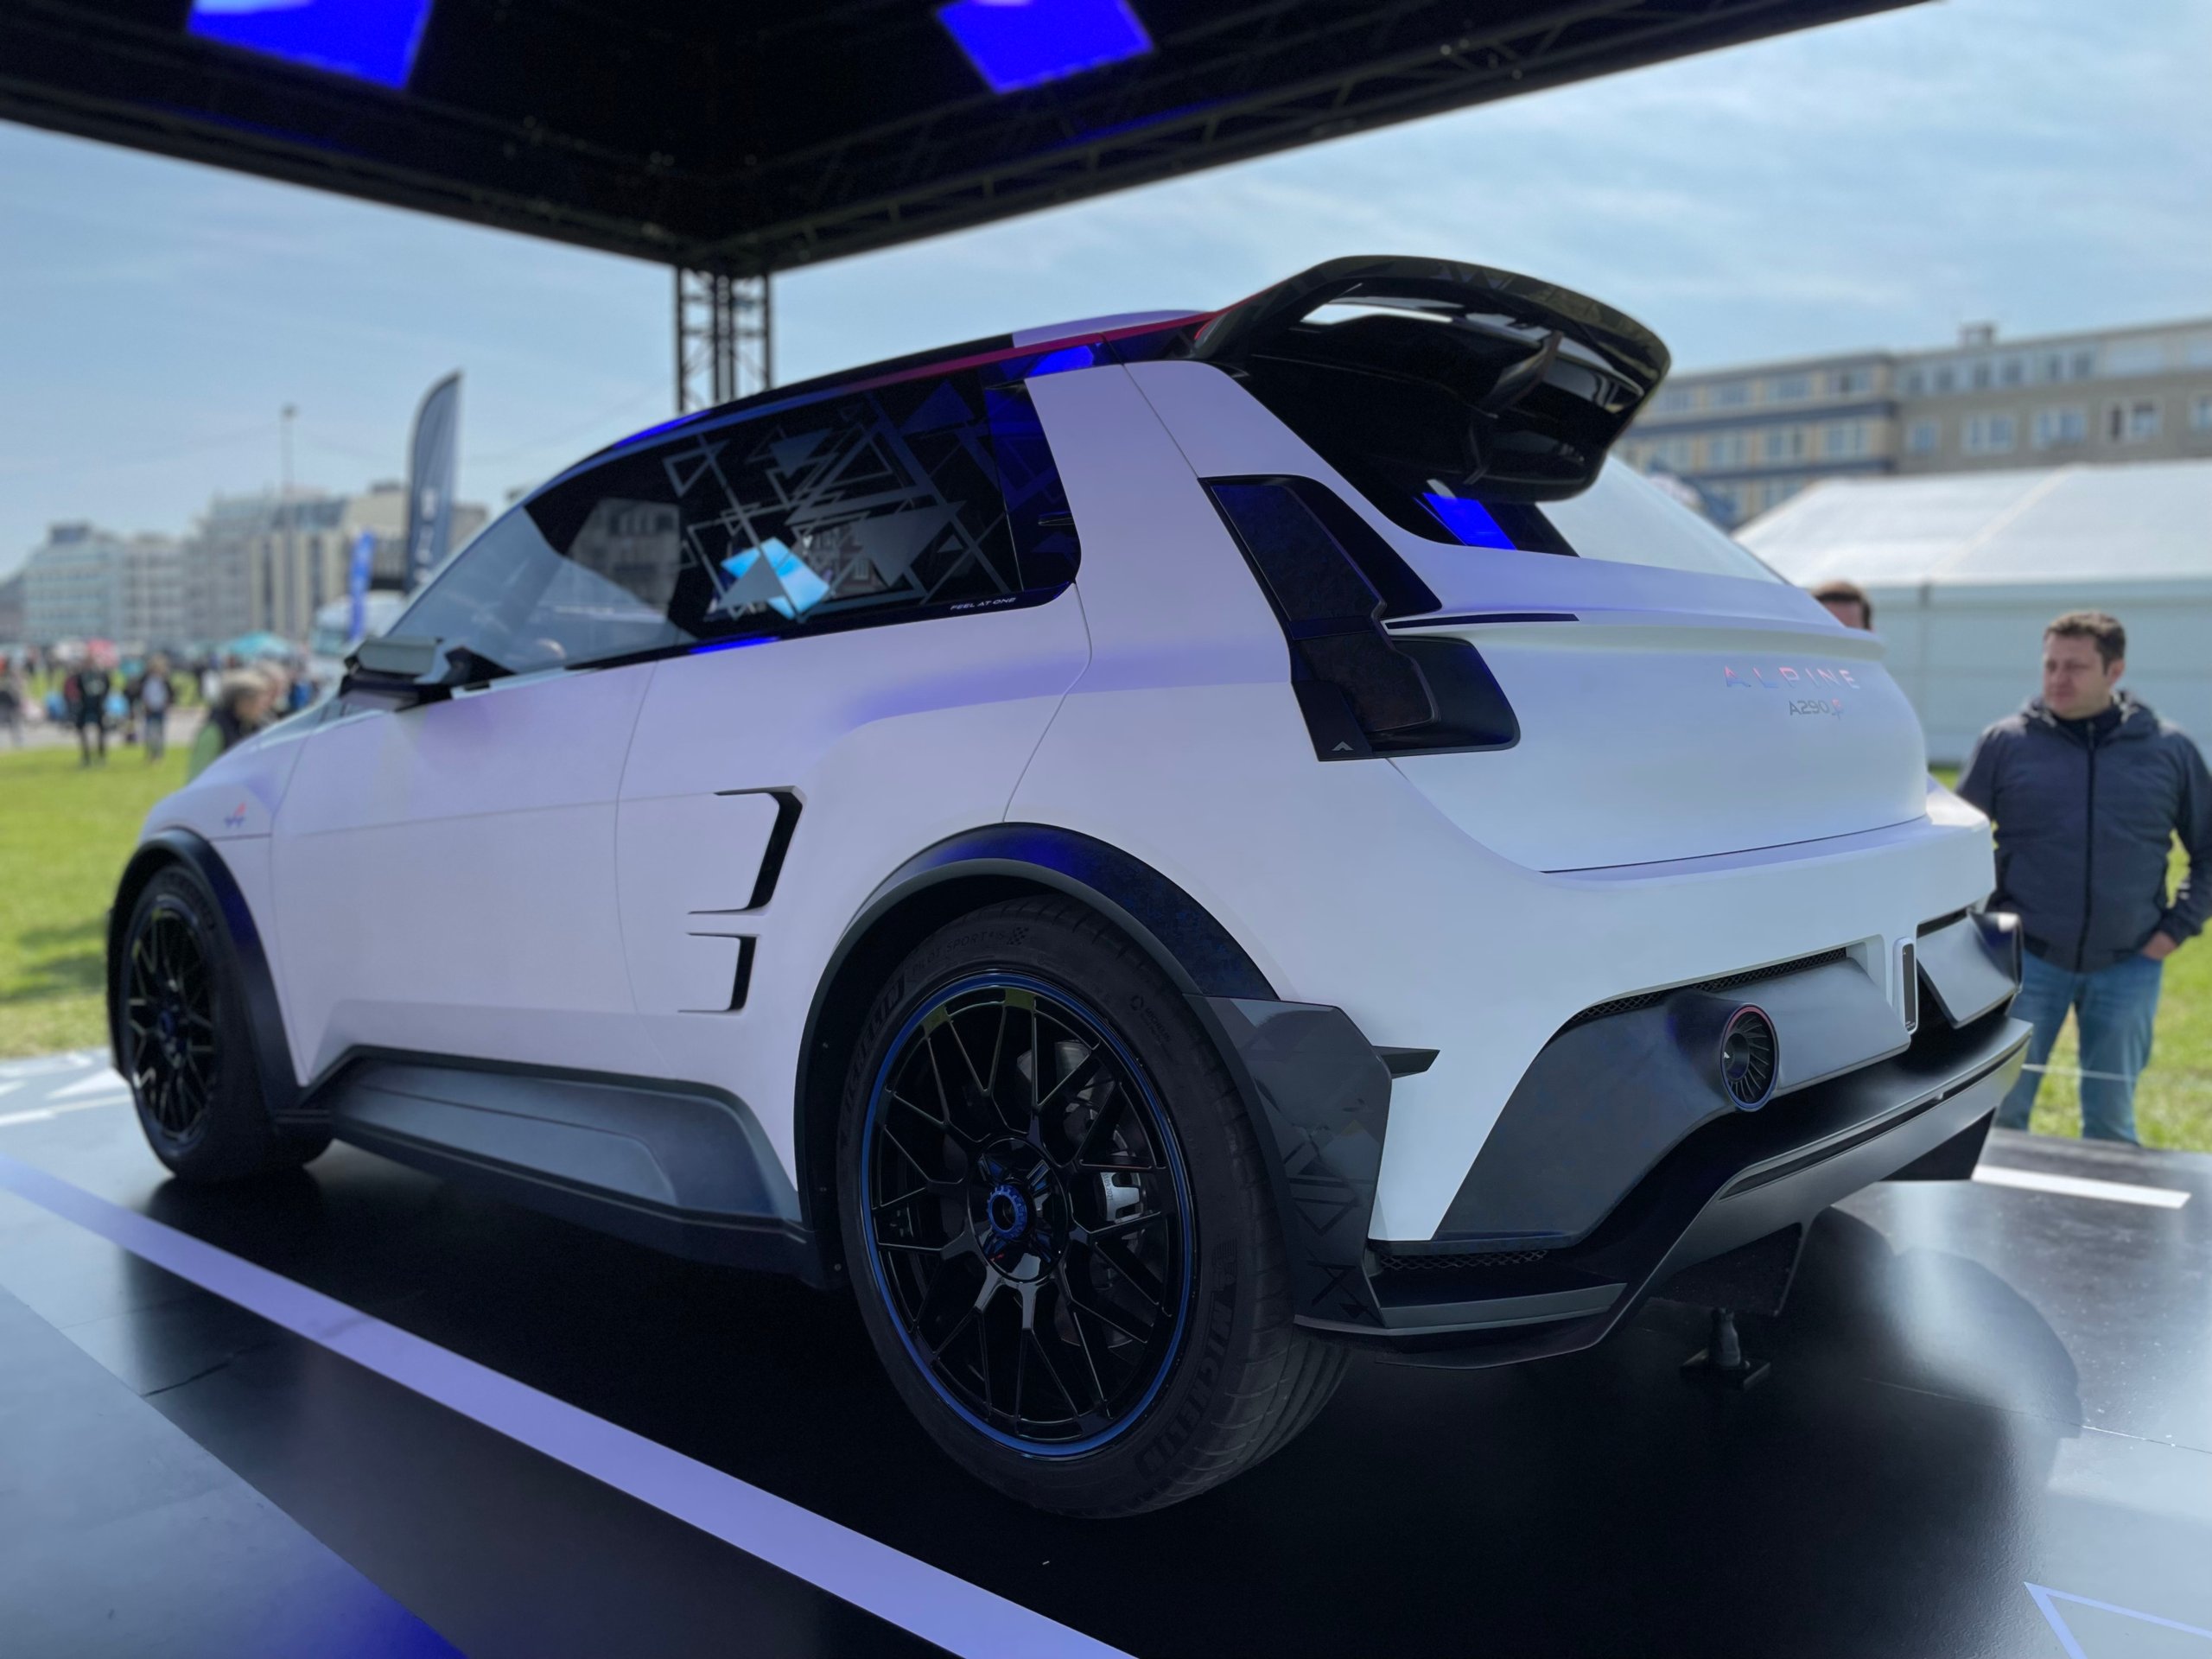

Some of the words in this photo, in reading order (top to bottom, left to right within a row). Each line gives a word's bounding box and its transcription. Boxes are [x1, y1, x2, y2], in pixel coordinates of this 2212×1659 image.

[1723, 665, 1860, 690] ALPINE
[946, 931, 988, 953] SPORT
[1141, 1298, 1234, 1478] MICHELIN
